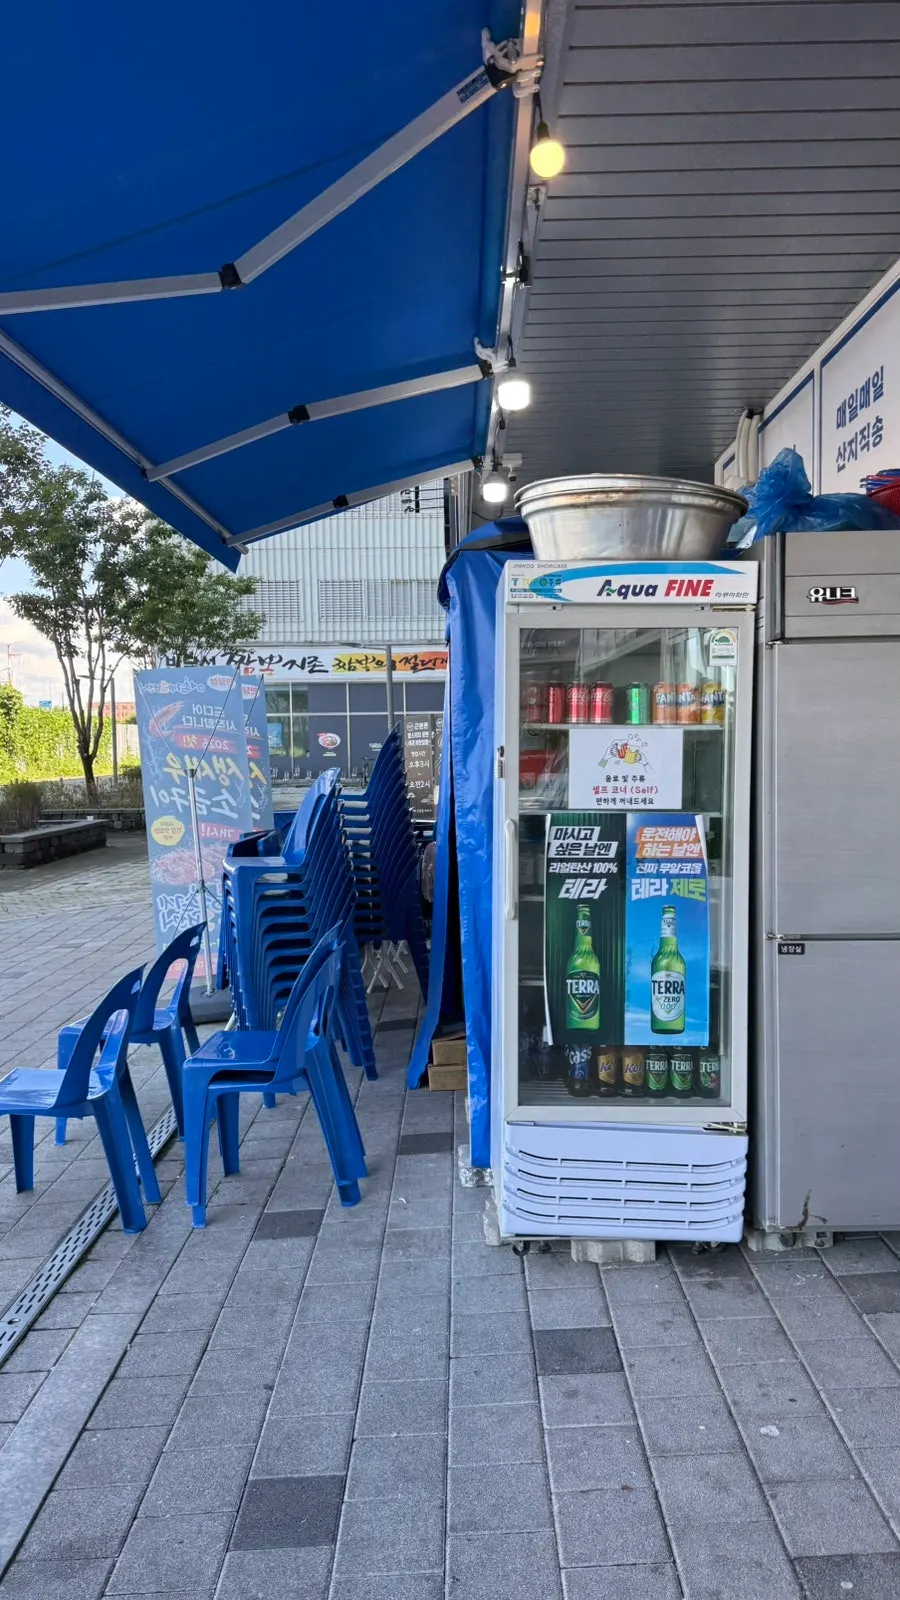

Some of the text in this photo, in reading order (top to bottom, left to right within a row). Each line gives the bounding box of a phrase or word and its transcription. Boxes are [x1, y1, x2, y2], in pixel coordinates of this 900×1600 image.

[836, 365, 884, 430] 매일매일
[836, 415, 884, 473] 산지직송
[596, 579, 714, 600] Aqua FINE
[808, 587, 857, 602] 유니크
[408, 760, 430, 769] 오후3시
[409, 781, 431, 789] 오전2시
[605, 774, 646, 783] 음료 및 주류
[592, 785, 659, 795] 셀프 코너 (Self)
[595, 797, 654, 805] 편하게 꺼내드세요
[553, 827, 595, 841] 마시고
[641, 826, 697, 842] 운전해야
[554, 842, 612, 857] 싶은 날엔
[642, 843, 701, 857] 하는 날엔
[548, 862, 618, 874] 리얼탄산 100%
[636, 862, 702, 874] 진짜 무알코올
[558, 878, 608, 900] 테라
[631, 878, 707, 903] 테라 제로
[780, 945, 802, 953] 냉장실
[566, 979, 600, 994] TERRA
[651, 979, 685, 995] TERRA
